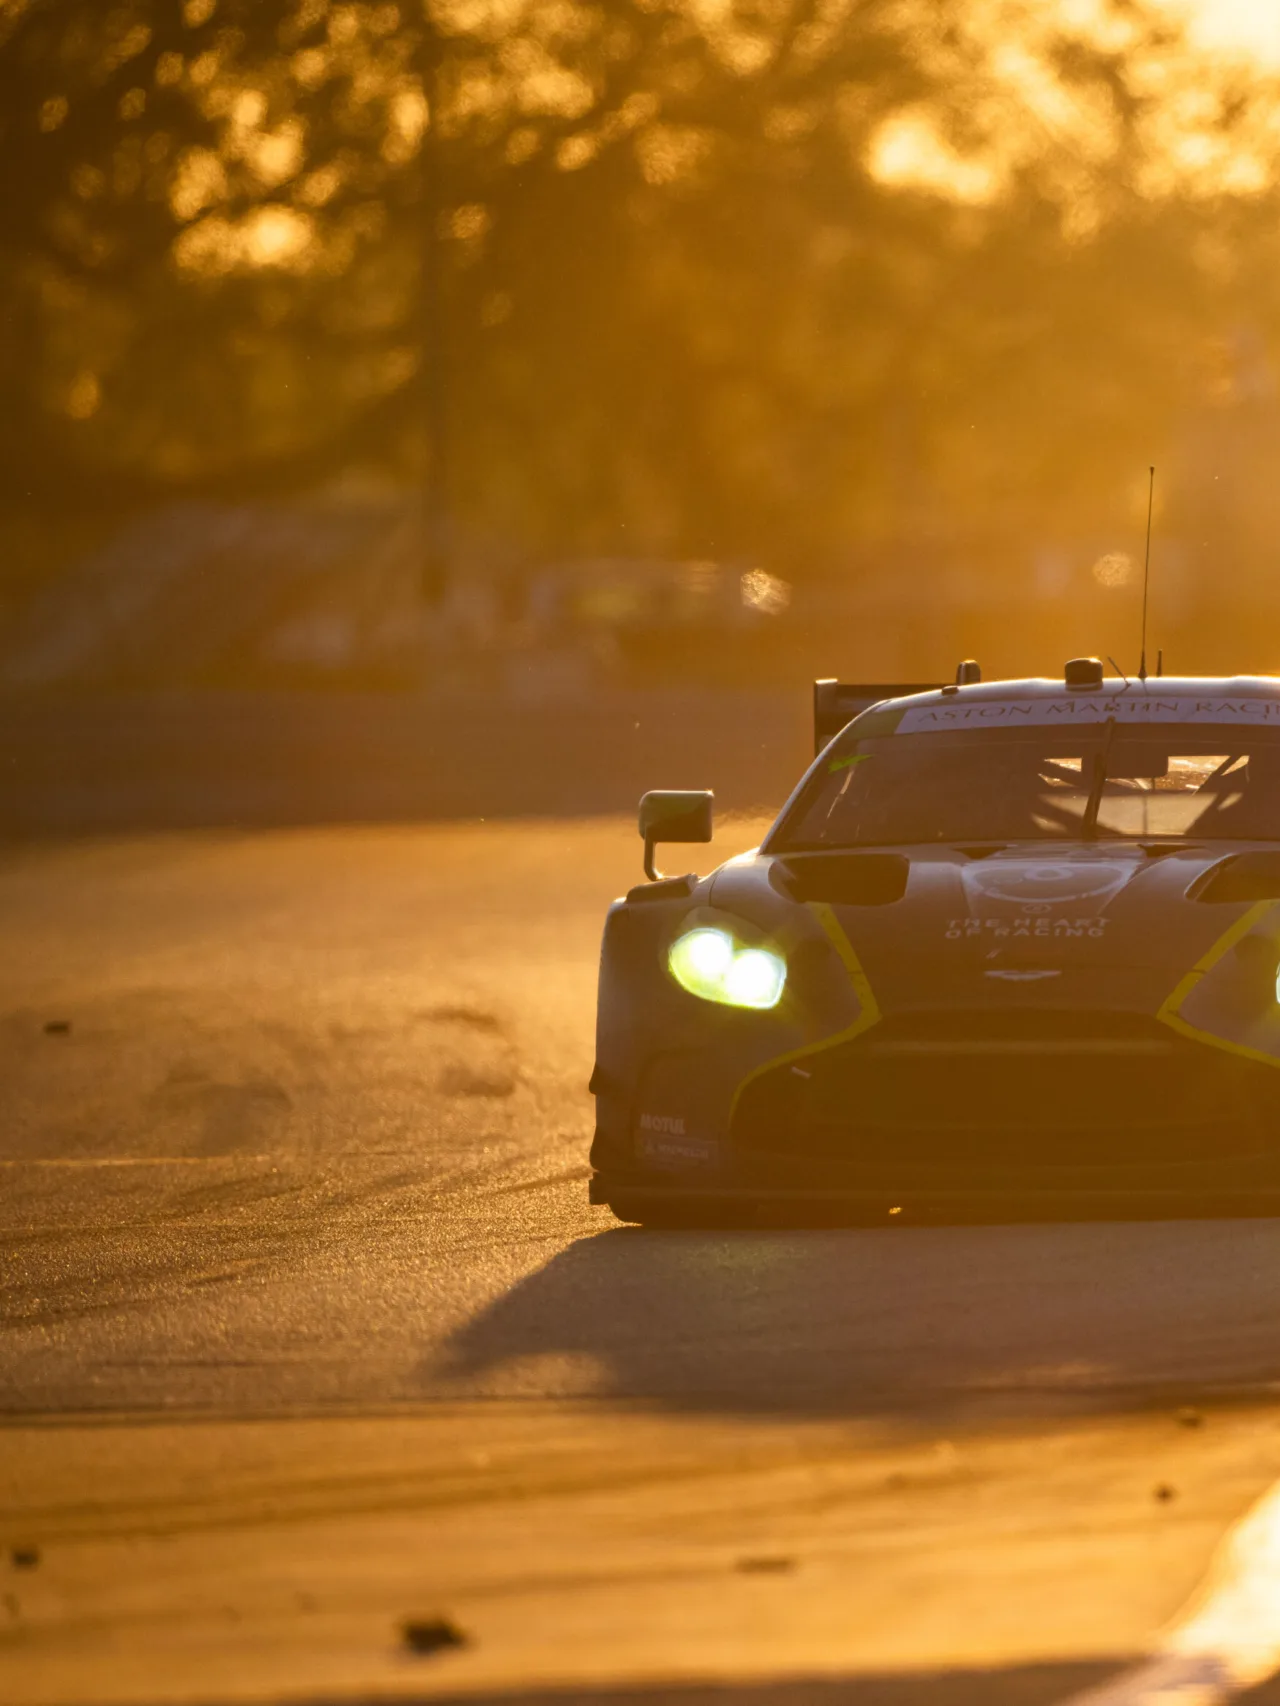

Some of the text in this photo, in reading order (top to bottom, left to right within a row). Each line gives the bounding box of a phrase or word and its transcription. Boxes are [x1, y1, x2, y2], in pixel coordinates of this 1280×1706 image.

[919, 706, 1032, 722] ASTON
[1046, 701, 1178, 714] MARTIN
[946, 916, 1112, 928] THE HEART
[944, 927, 1105, 939] OF RACING
[640, 1112, 686, 1135] MOTUL
